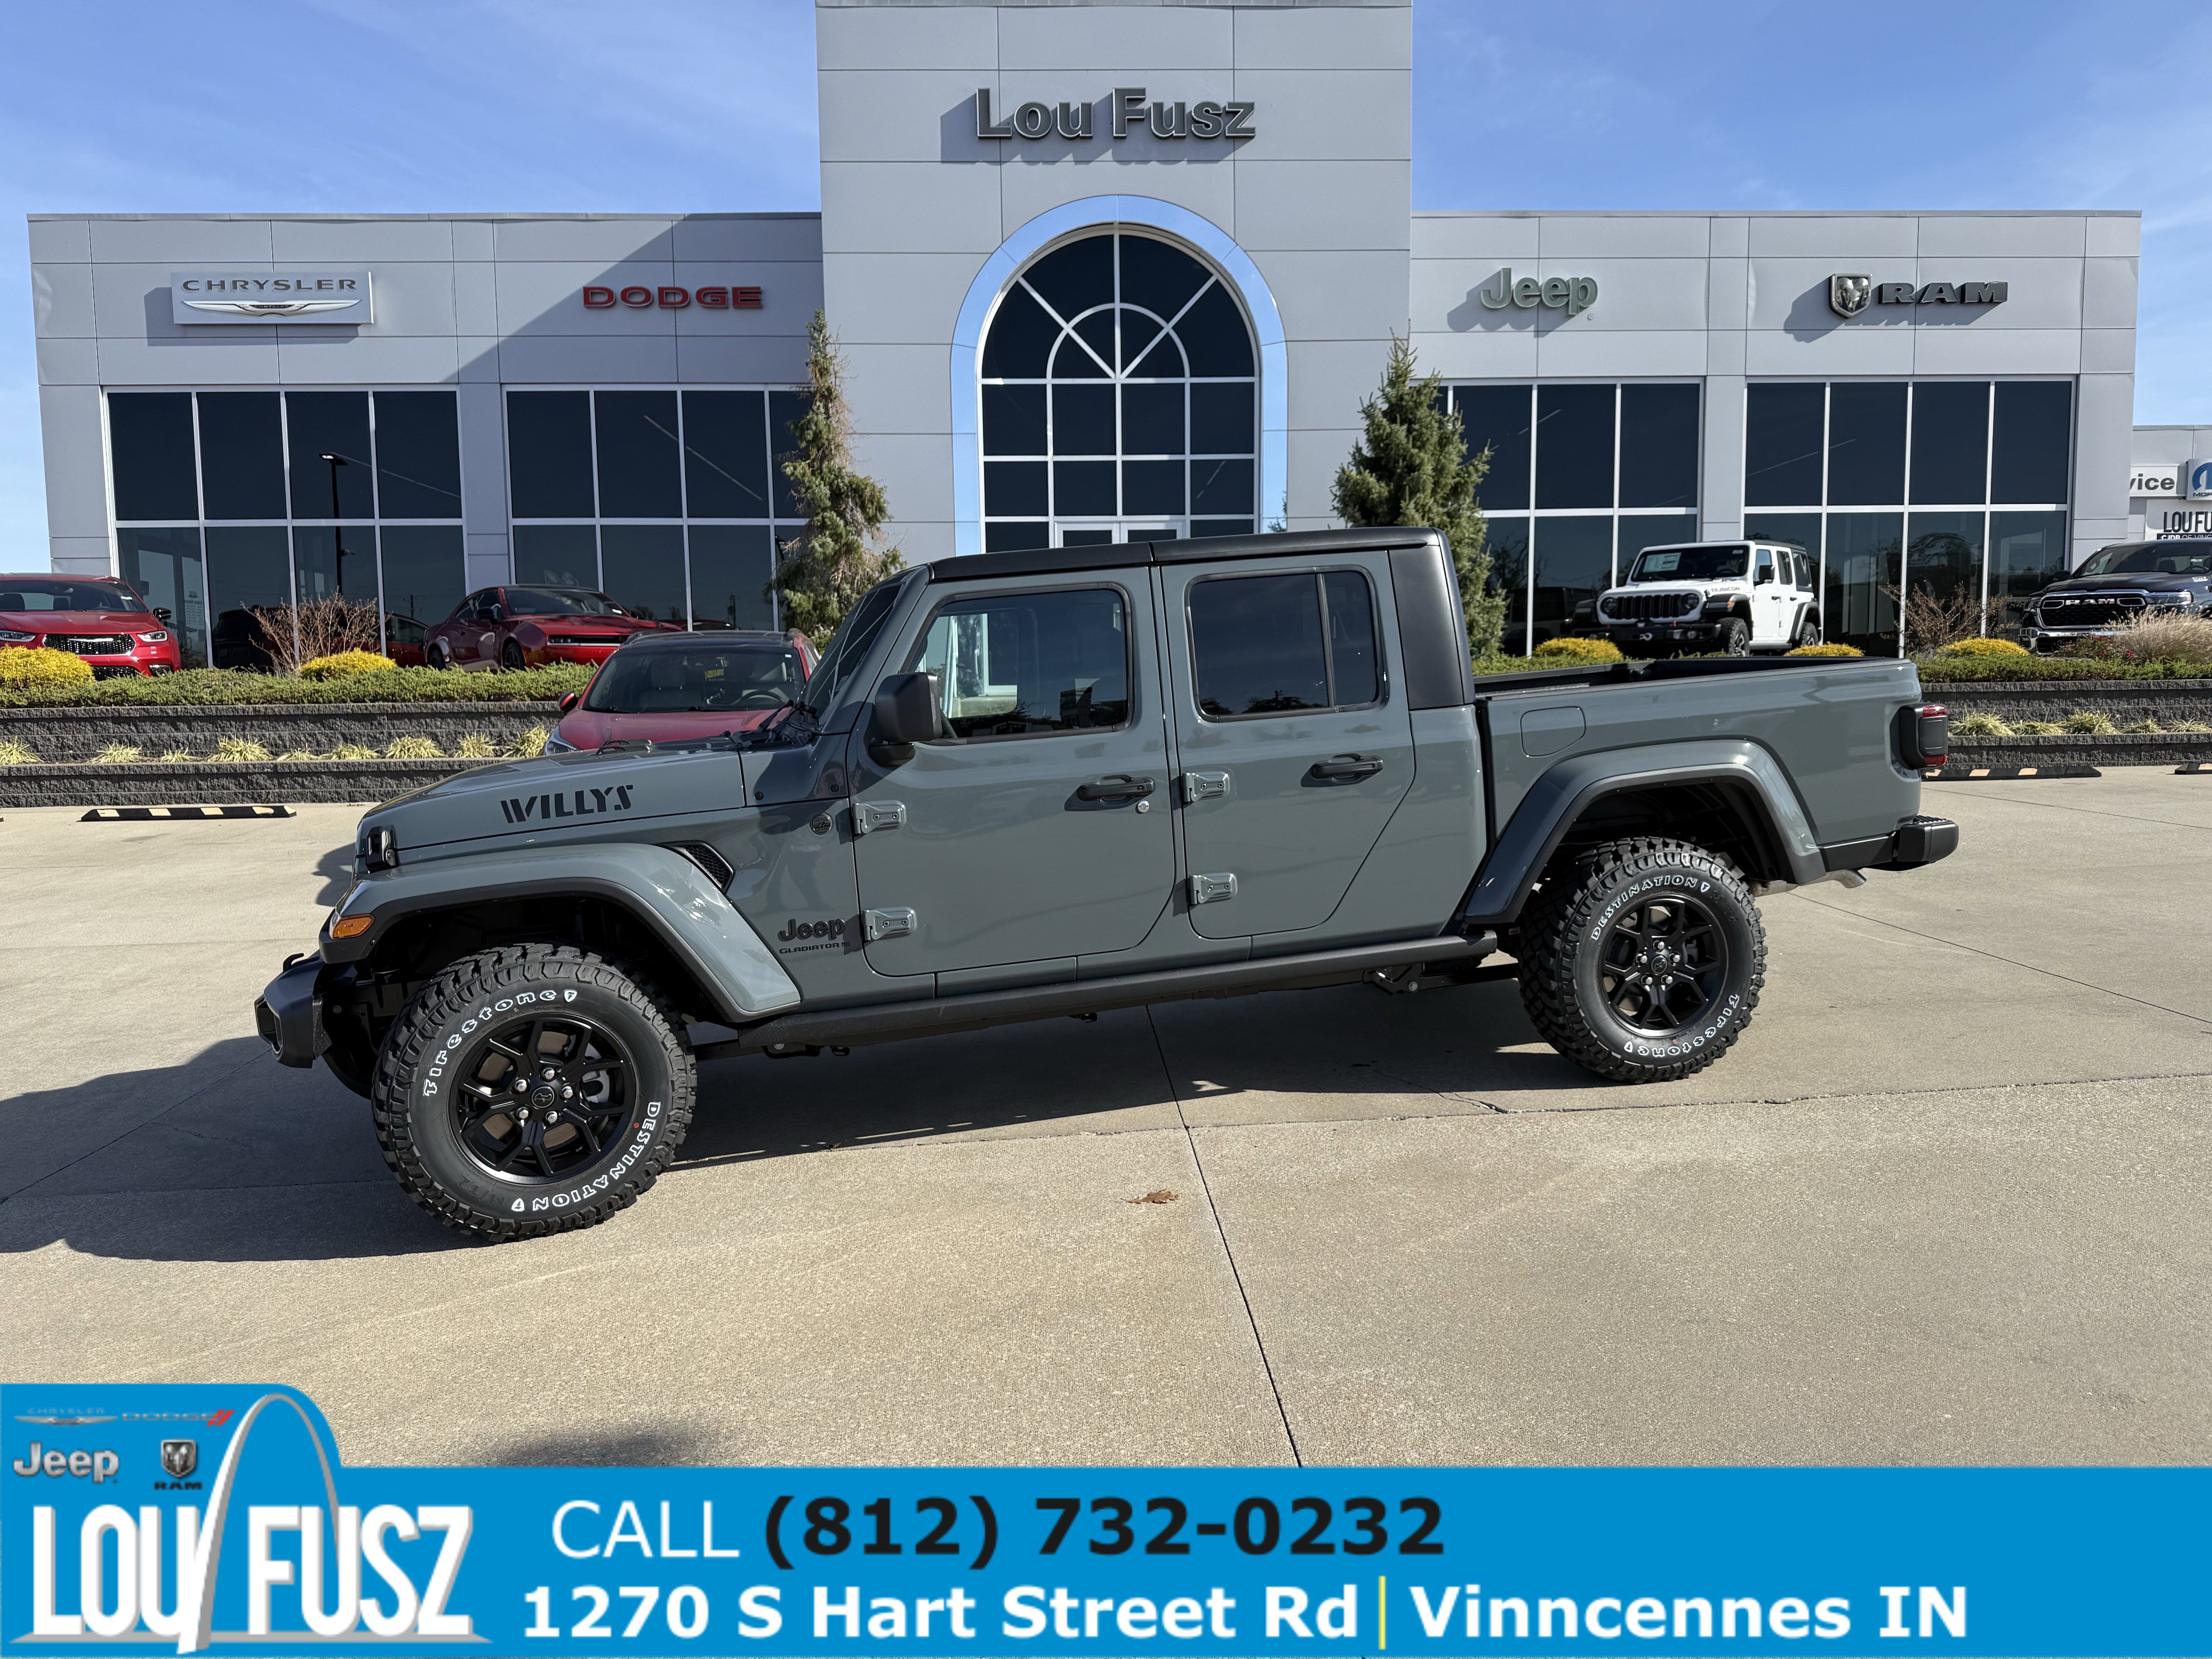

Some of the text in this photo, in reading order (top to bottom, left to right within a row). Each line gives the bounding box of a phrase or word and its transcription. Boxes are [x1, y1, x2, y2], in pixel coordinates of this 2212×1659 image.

[976, 88, 1256, 140] Lou Fusz
[182, 279, 357, 292] CHRYSLER
[582, 286, 763, 309] DODGE
[1480, 268, 1598, 315] Jeep
[1878, 281, 2008, 304] RAM
[2164, 511, 2193, 532] LOU
[500, 784, 634, 824] WILLYS
[1590, 874, 1698, 940] DESTINATION
[778, 918, 846, 941] Jeep
[779, 942, 840, 954] GLADIATOR
[422, 989, 556, 1097] Firestone
[1637, 994, 1740, 1057] Firestone
[532, 1101, 661, 1211] DESTINATION
